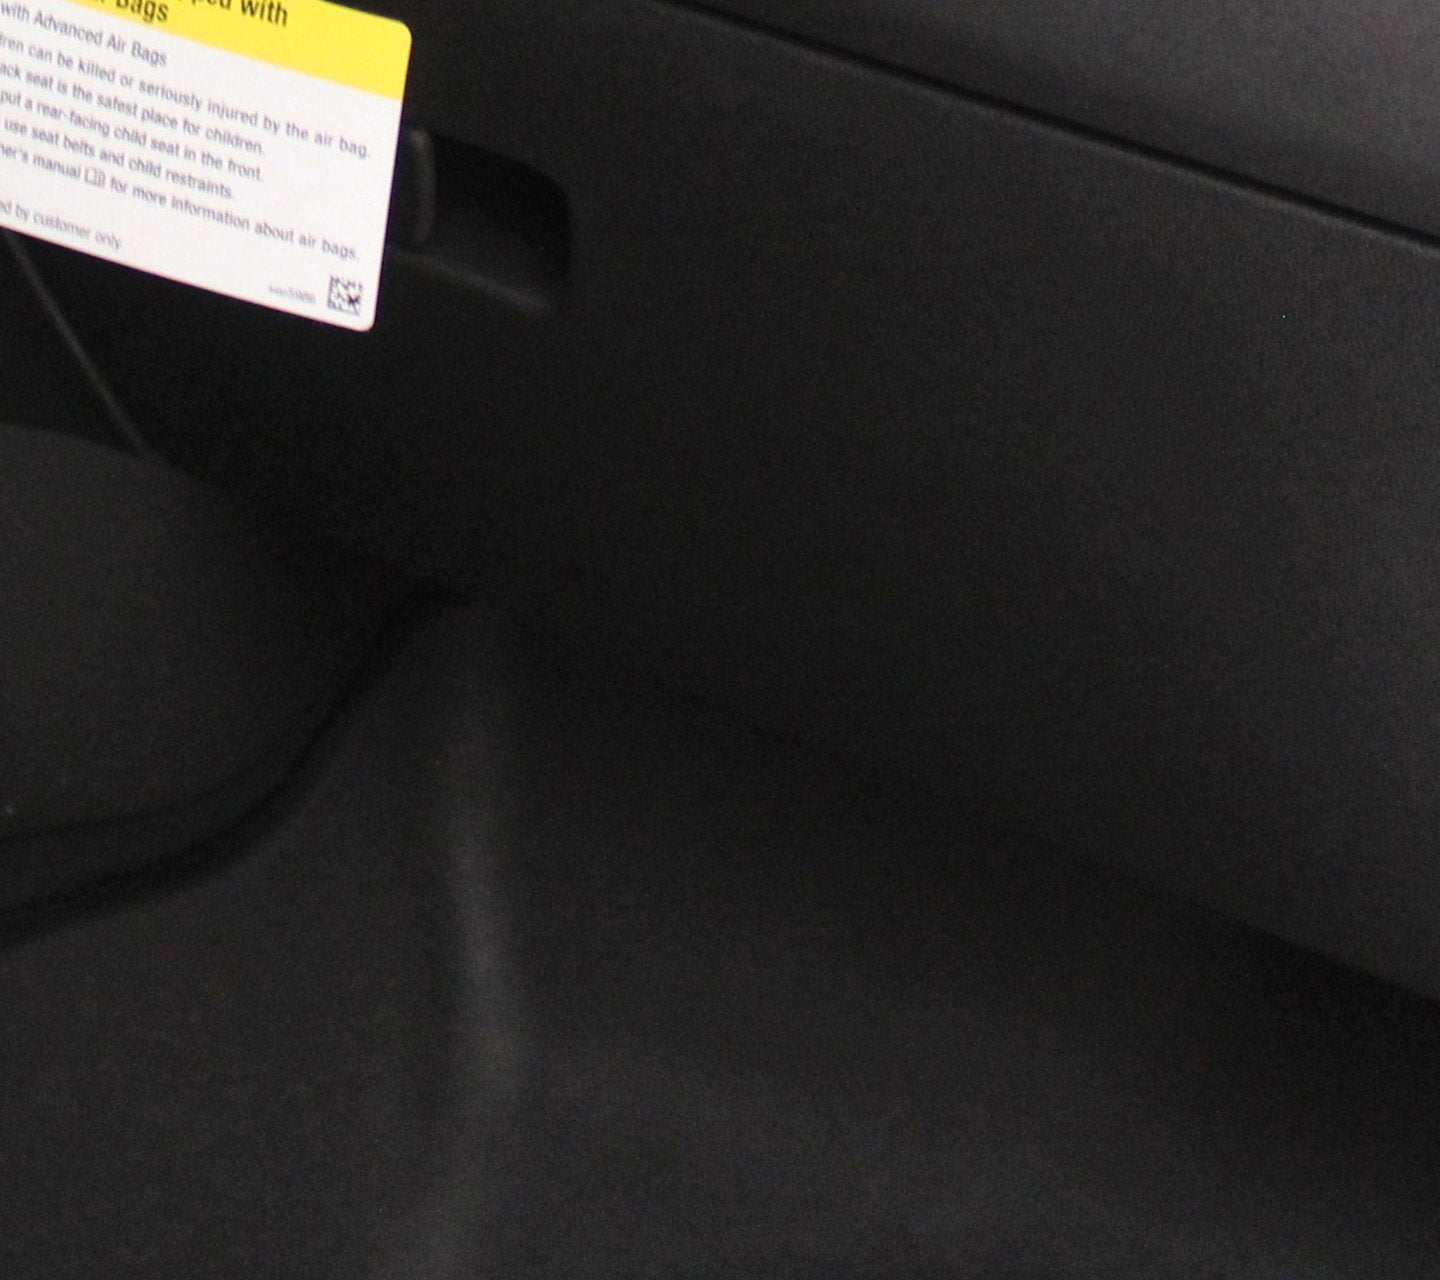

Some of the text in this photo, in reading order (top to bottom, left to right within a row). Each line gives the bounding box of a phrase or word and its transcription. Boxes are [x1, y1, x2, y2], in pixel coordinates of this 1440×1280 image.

[0, 2, 29, 21] with
[33, 10, 103, 45] Advanced
[106, 33, 126, 51] Air
[130, 40, 166, 65] Bags
[25, 71, 53, 90] seat
[56, 79, 67, 95] is
[72, 83, 92, 102] the
[96, 94, 137, 117] safest
[140, 107, 178, 129] place
[182, 117, 201, 135] for
[27, 44, 52, 62] can
[56, 50, 73, 69] be
[77, 57, 116, 83] killed
[119, 73, 134, 88] or
[138, 79, 202, 111] seriously
[207, 98, 258, 126] injured
[262, 114, 280, 134] by
[285, 121, 308, 140] the
[313, 132, 333, 146] air
[3, 118, 27, 135] use
[31, 126, 59, 146] seat
[62, 134, 94, 157] belts
[99, 149, 125, 166] and
[128, 157, 161, 177] child
[24, 97, 33, 111] a
[113, 125, 147, 146] child
[150, 138, 180, 157] seat
[183, 145, 196, 160] in
[200, 150, 222, 168] the
[32, 153, 81, 178] manual
[109, 175, 128, 193] for
[132, 185, 166, 206] more
[170, 195, 249, 229] information
[254, 221, 294, 242] about
[298, 234, 316, 246] air
